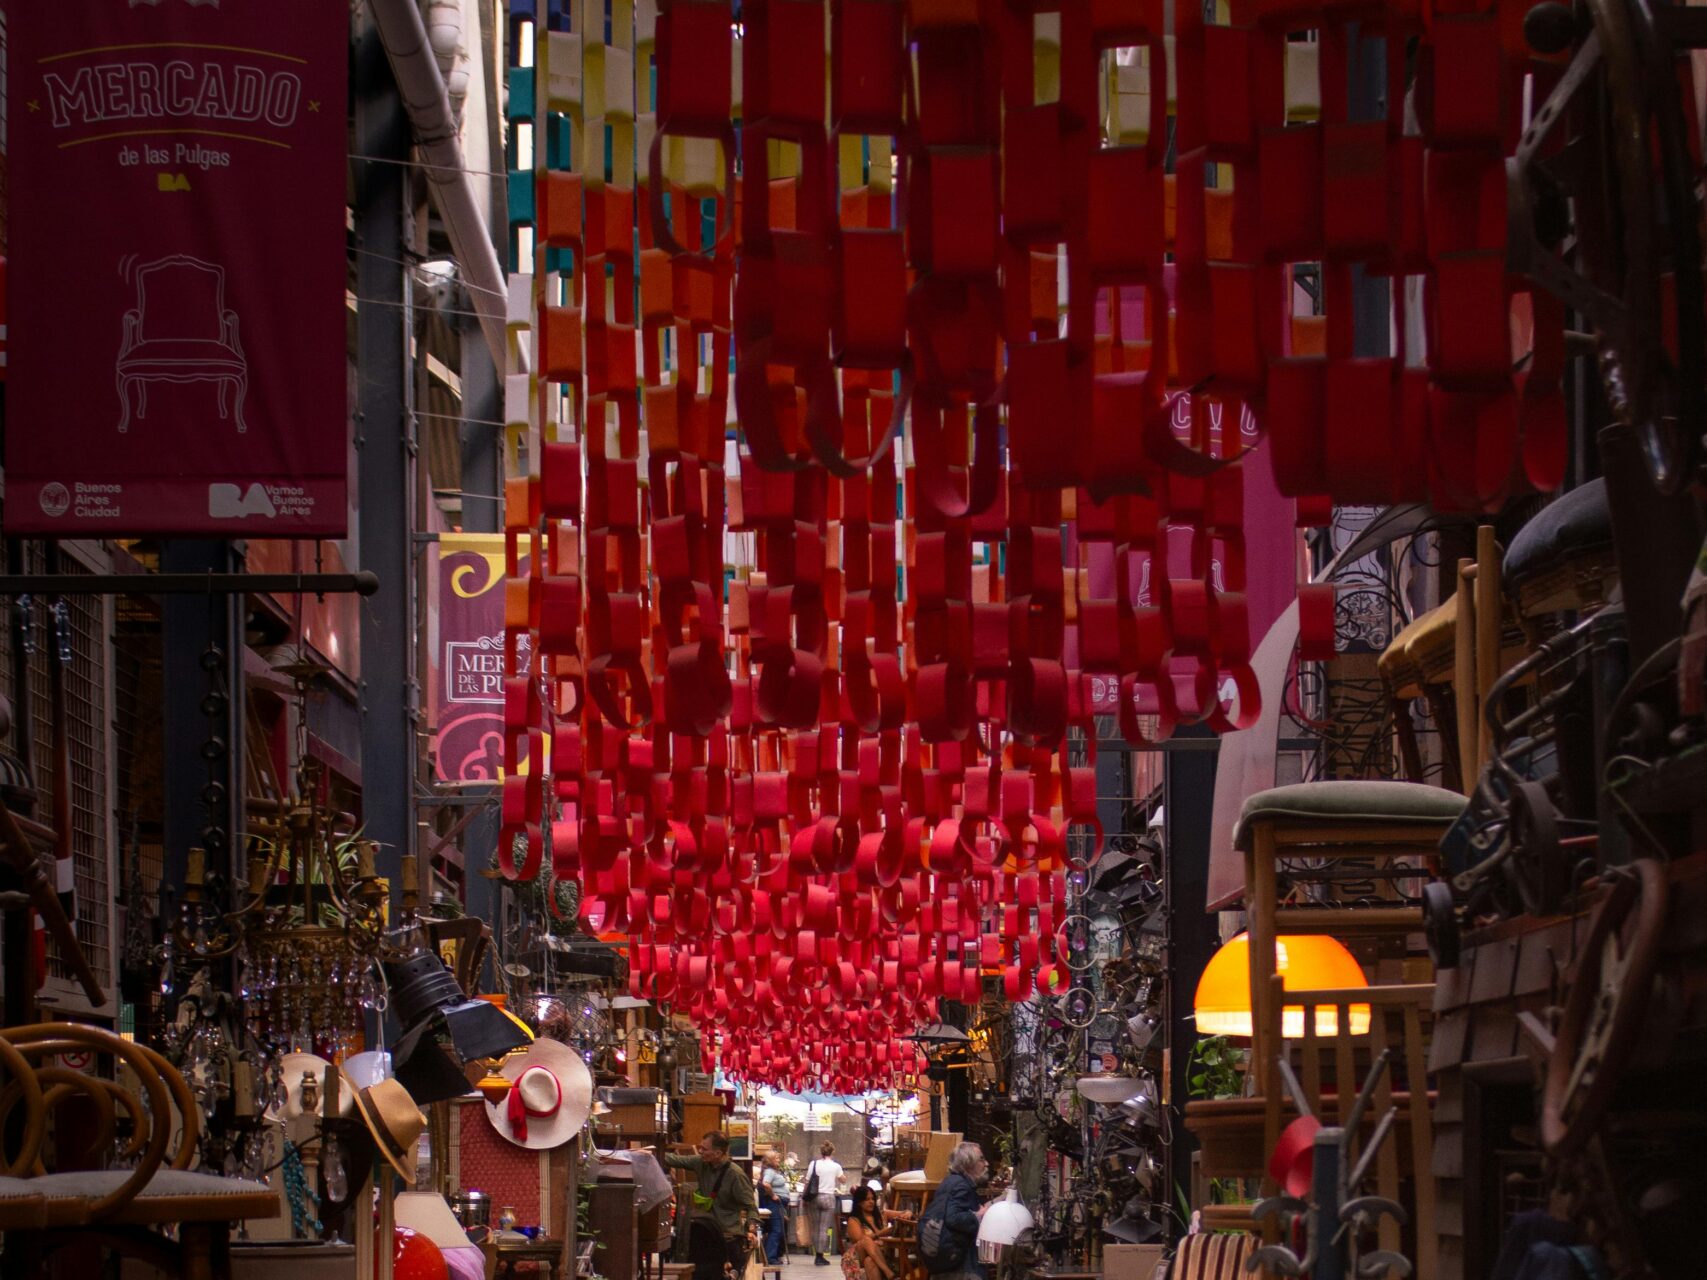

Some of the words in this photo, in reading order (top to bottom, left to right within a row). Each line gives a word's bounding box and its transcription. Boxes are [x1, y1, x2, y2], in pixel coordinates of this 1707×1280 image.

[43, 61, 301, 127] MERCADO
[118, 144, 140, 166] de
[143, 143, 170, 165] las
[175, 143, 231, 171] Pulgas
[157, 172, 193, 192] BA
[74, 482, 122, 494] Buenos
[266, 485, 304, 496] Vamos
[74, 494, 110, 506] Aires
[208, 482, 277, 518] BA
[272, 495, 315, 506] Buenos
[74, 506, 121, 518] Ciudad
[279, 506, 311, 517] Aires
[459, 674, 475, 683] DE
[459, 684, 480, 694] LAS
